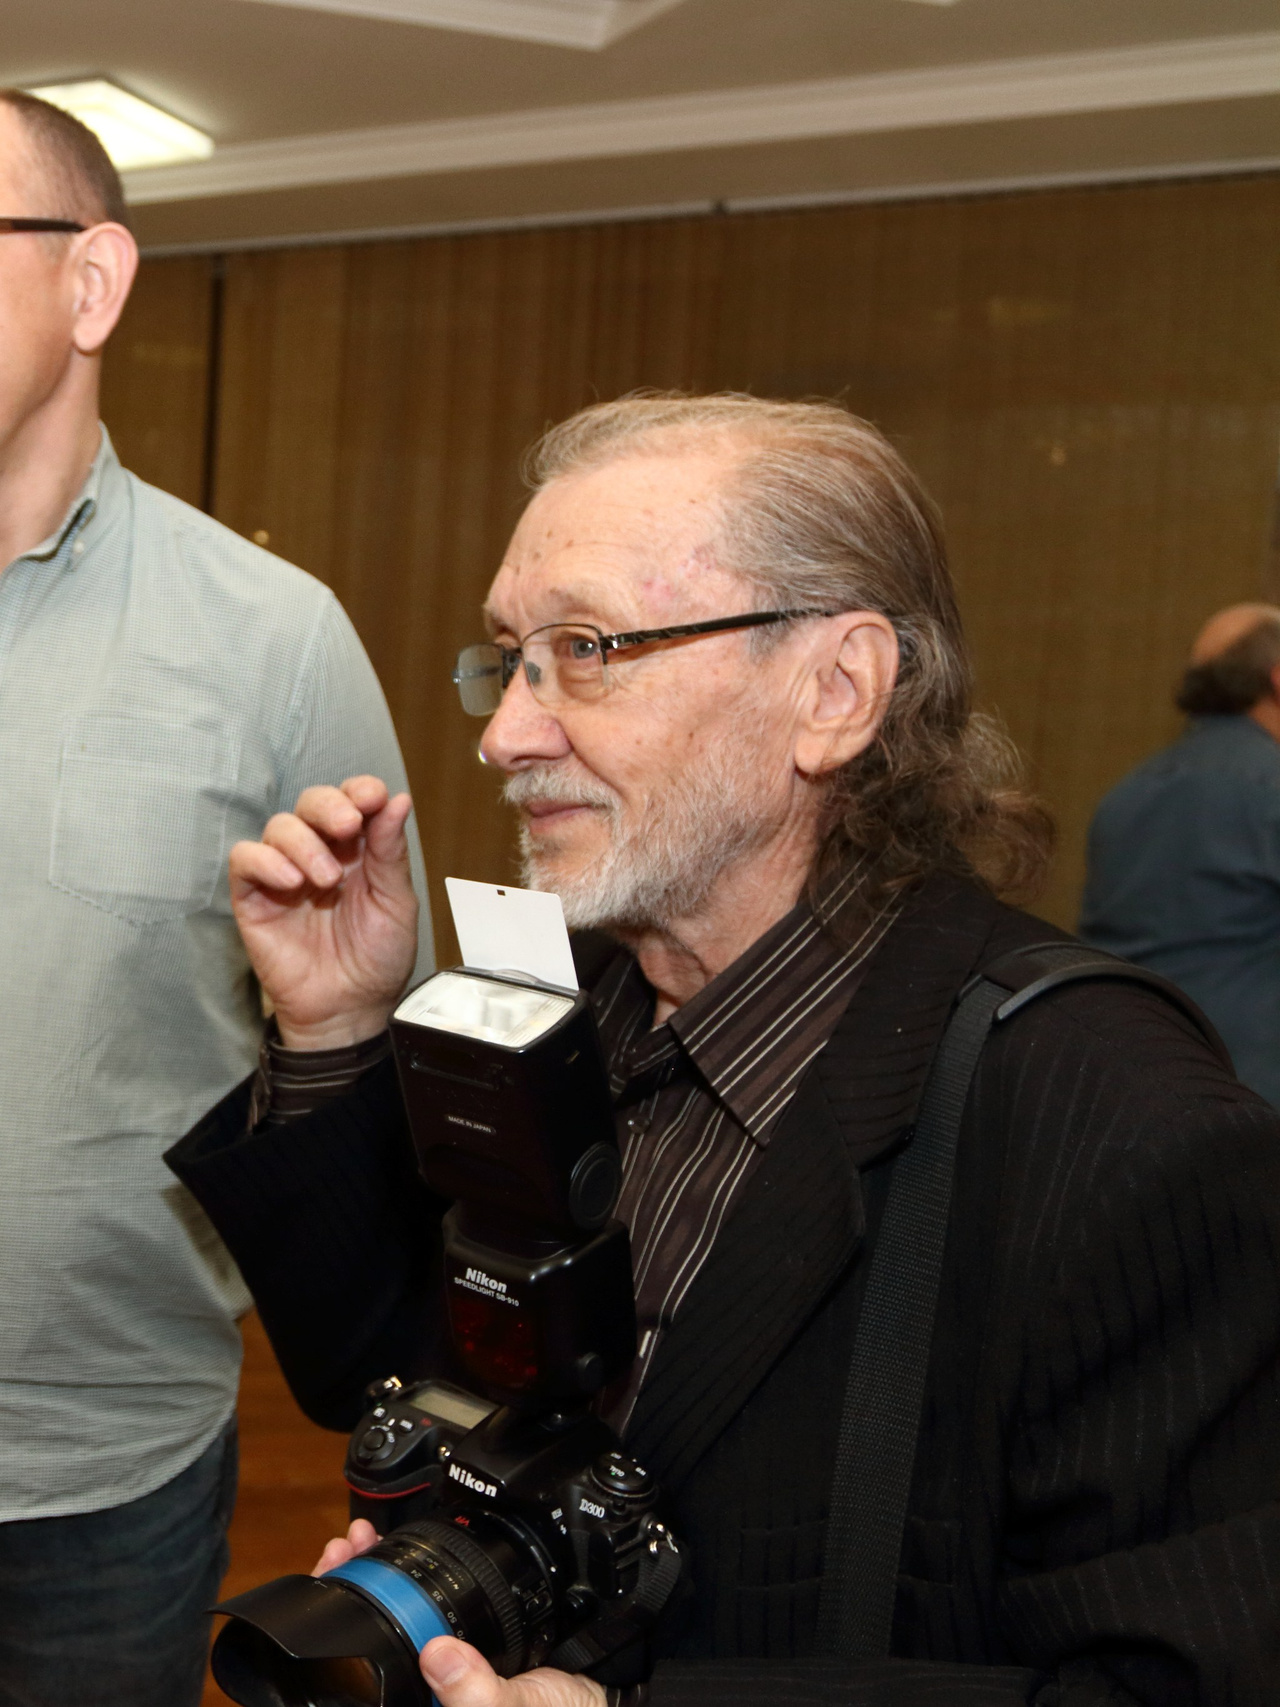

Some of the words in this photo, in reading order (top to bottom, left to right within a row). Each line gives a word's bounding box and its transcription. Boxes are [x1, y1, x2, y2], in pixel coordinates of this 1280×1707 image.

[473, 1122, 492, 1133] JAPAN
[465, 1267, 508, 1294] Nikon
[453, 1276, 496, 1298] SPEEDLIGHT
[495, 1292, 520, 1307] SB-910
[448, 1462, 498, 1498] Nikon
[578, 1497, 606, 1519] D300
[410, 1569, 422, 1578] 24
[431, 1590, 444, 1602] 35
[447, 1611, 458, 1624] 50
